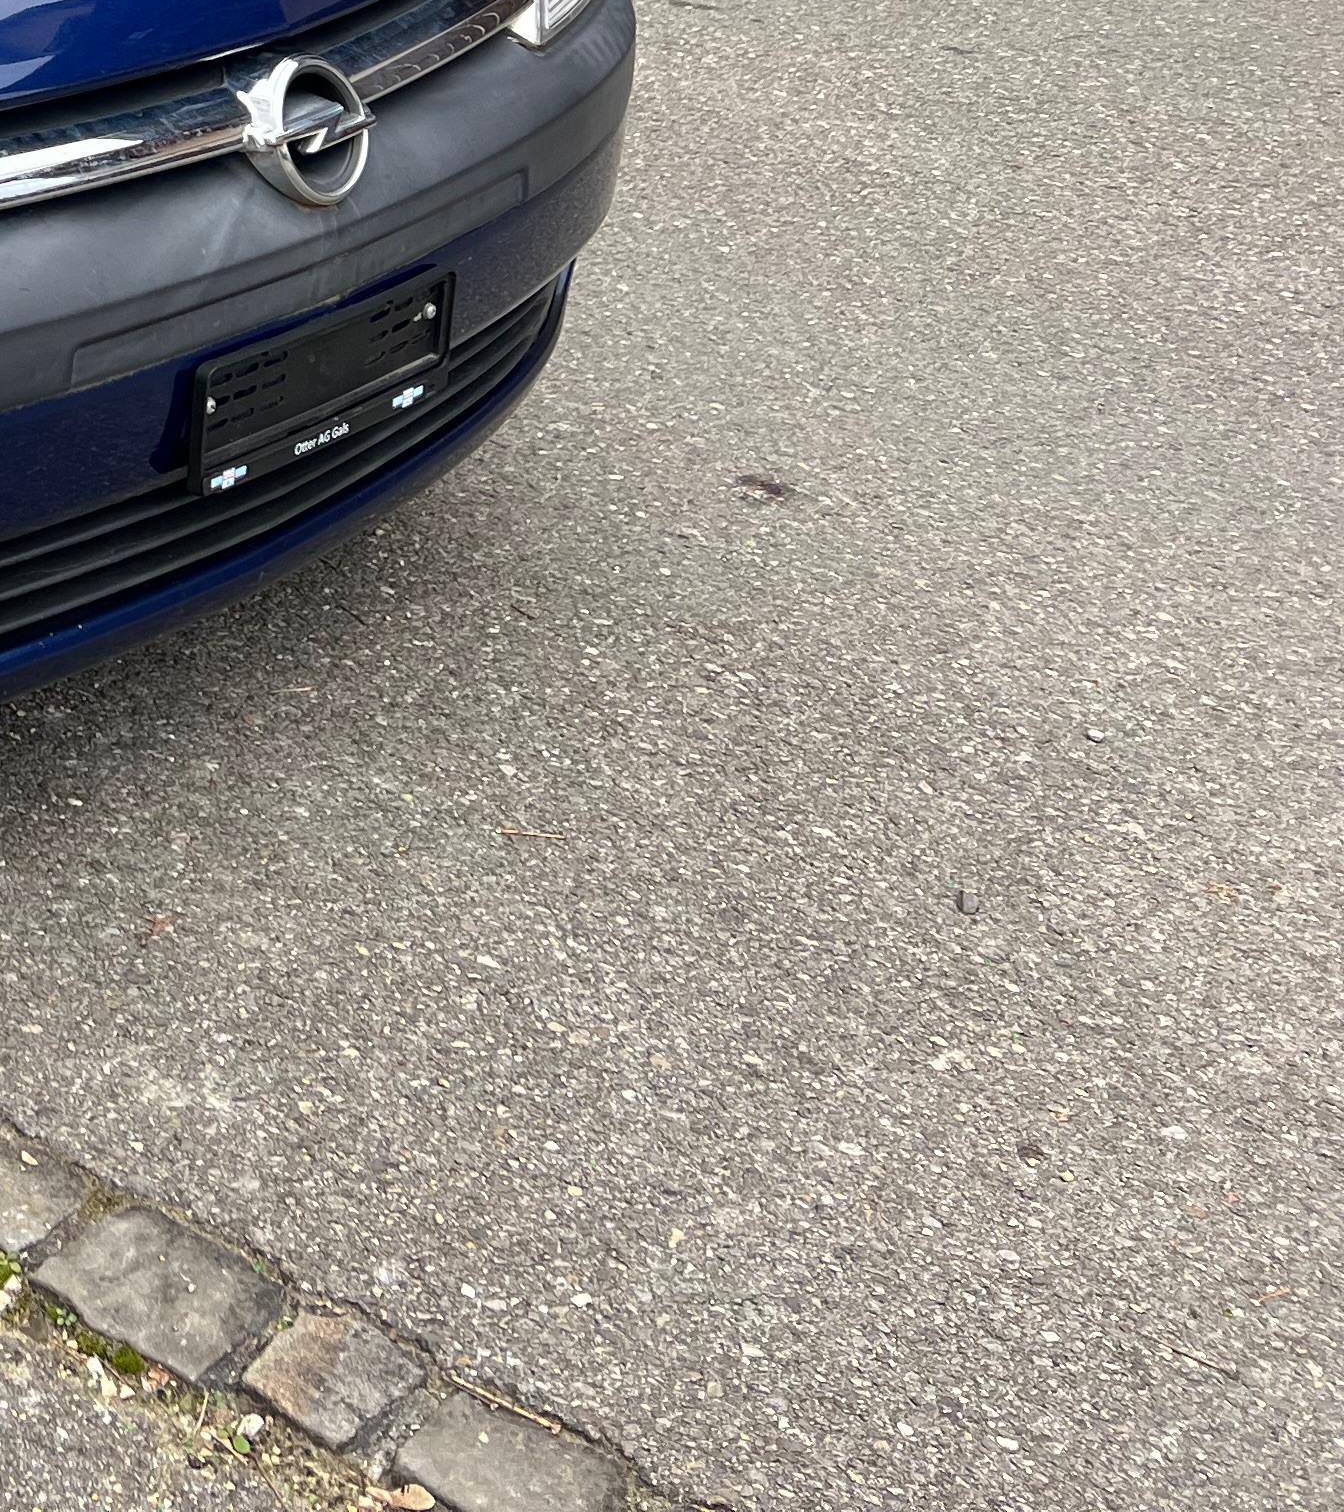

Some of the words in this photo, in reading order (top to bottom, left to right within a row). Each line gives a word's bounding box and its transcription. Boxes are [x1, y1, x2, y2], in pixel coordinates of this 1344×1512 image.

[294, 438, 317, 455] Otter
[318, 430, 331, 445] AG
[331, 422, 349, 439] Gals
